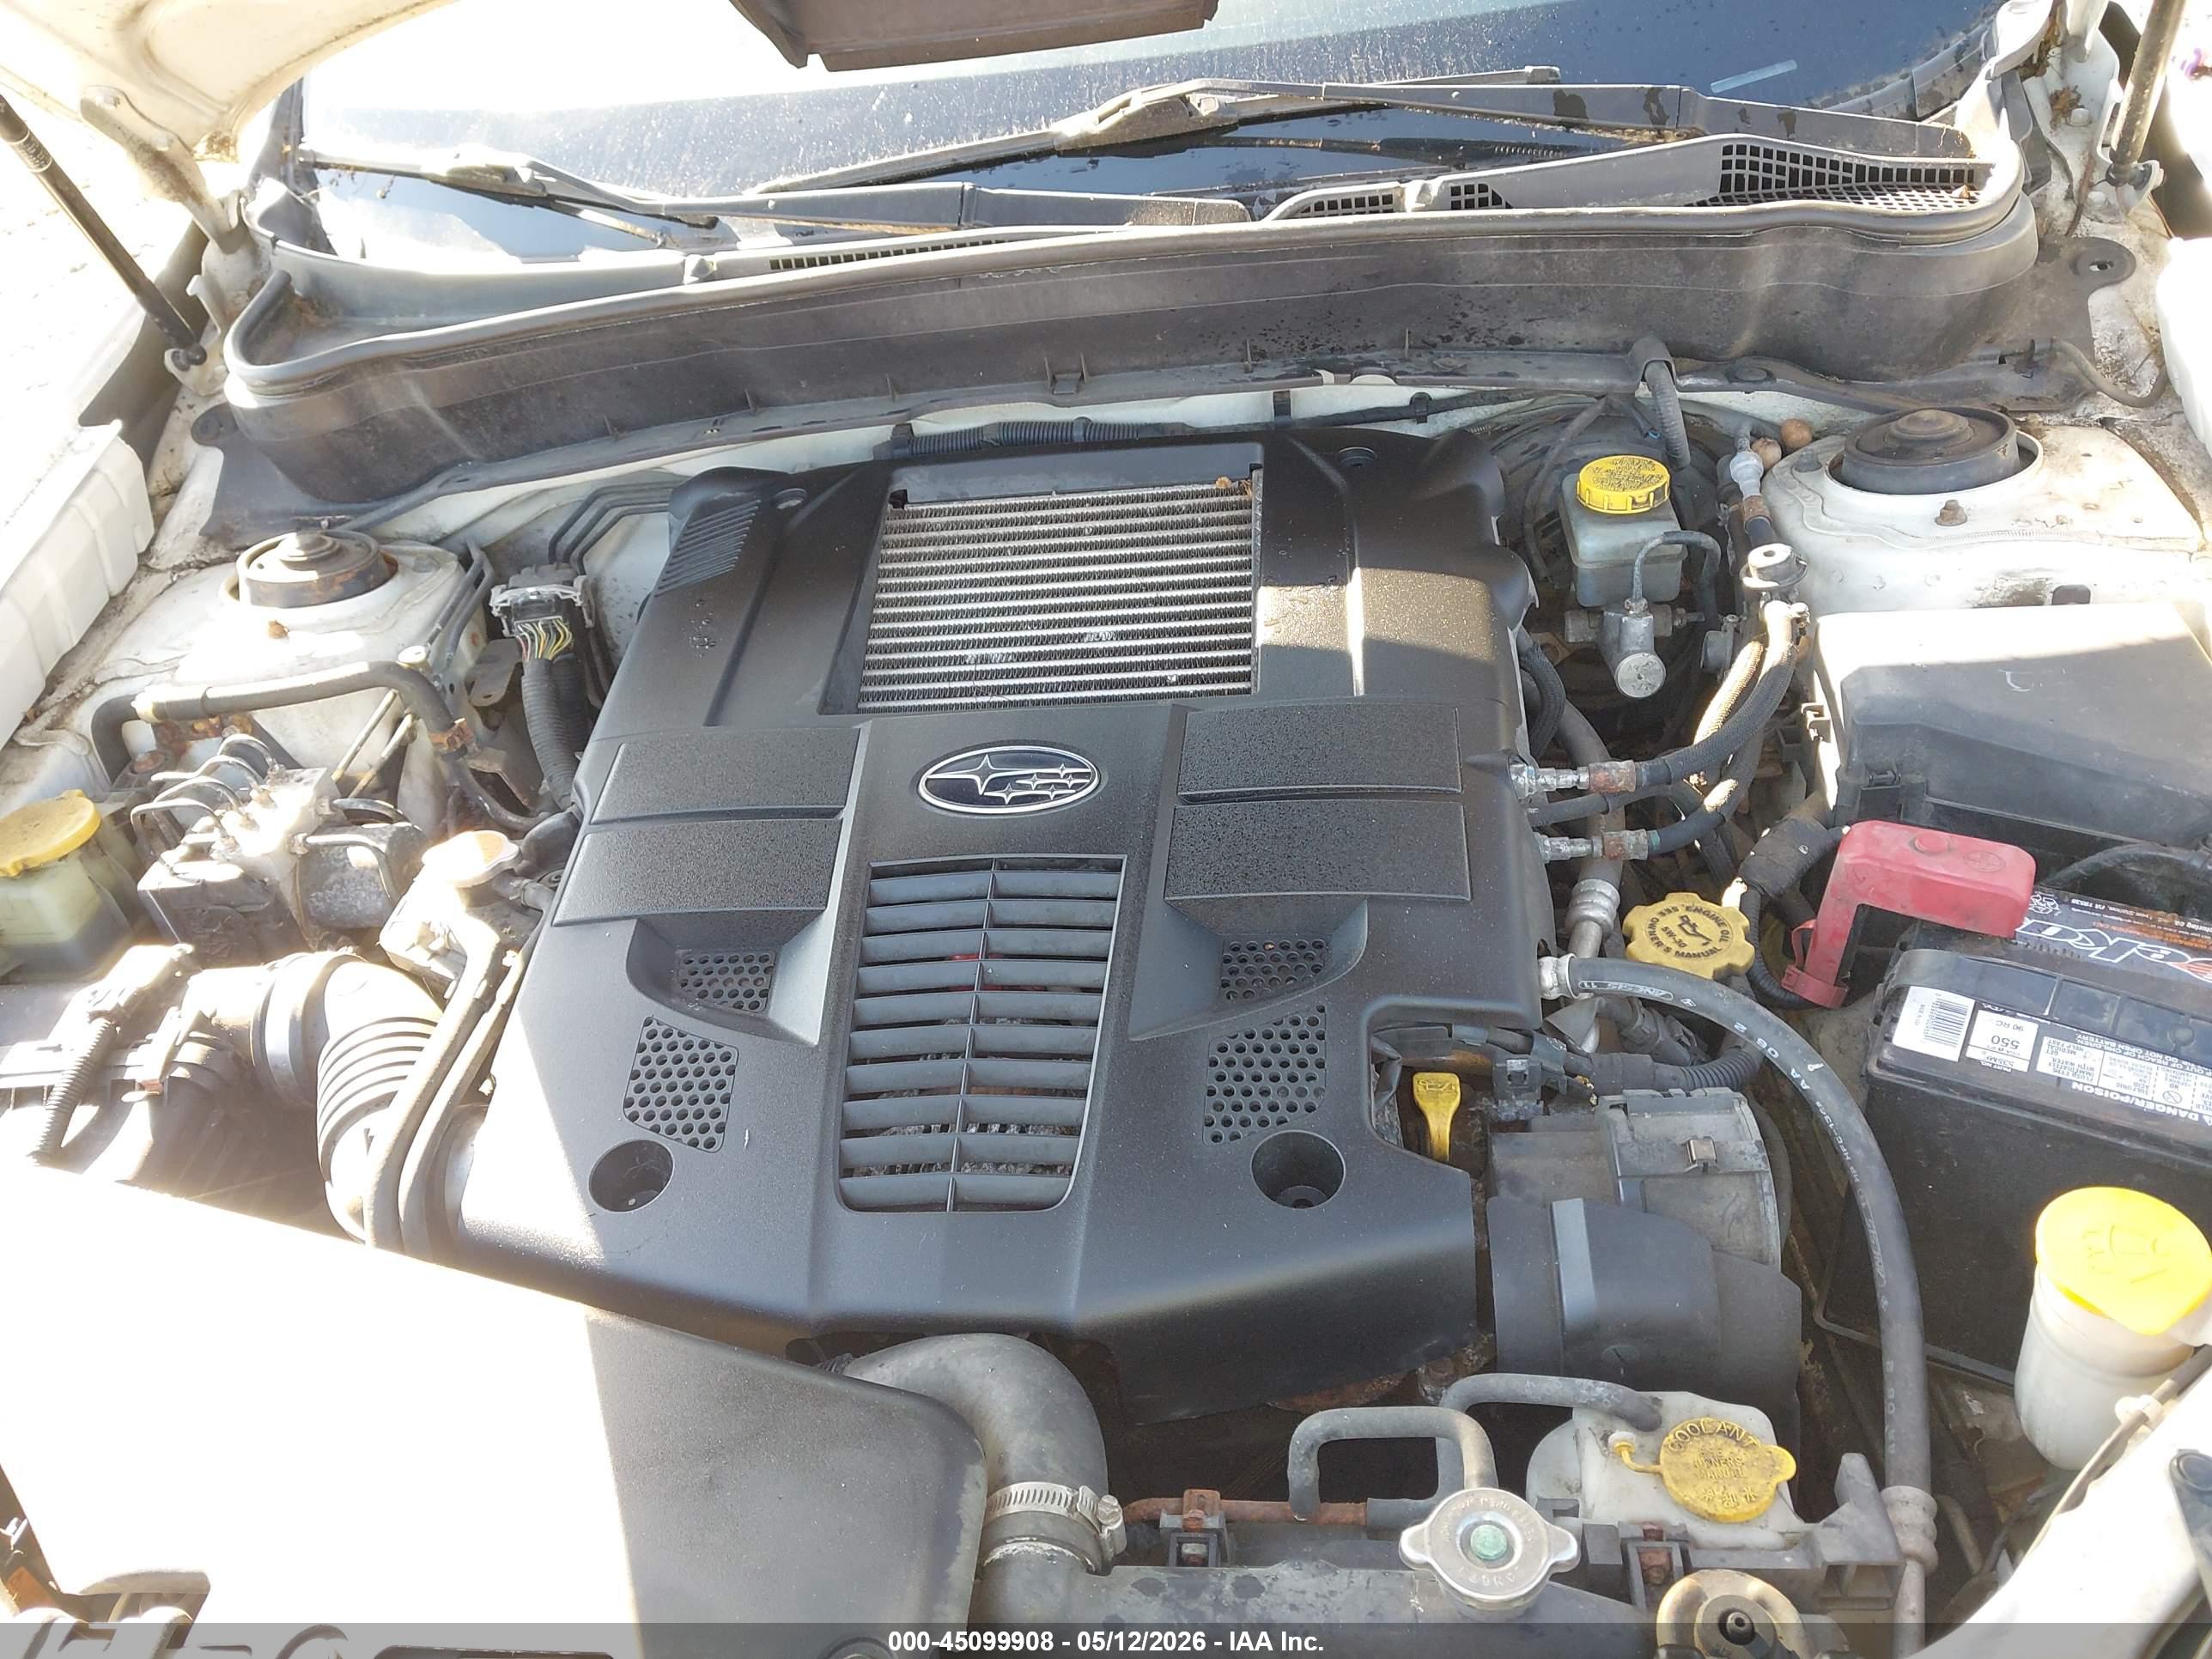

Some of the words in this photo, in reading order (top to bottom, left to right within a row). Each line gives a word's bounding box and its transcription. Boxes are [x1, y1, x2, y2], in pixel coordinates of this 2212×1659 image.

[1657, 906, 1679, 916] SEE
[1686, 905, 1728, 927] ENGINE
[1719, 929, 1730, 943] OIL
[1648, 917, 1672, 953] OWNER'S
[1661, 926, 1687, 948] 5W-30
[1674, 946, 1723, 958] MANUAL
[1734, 1021, 1747, 1033] 2
[1996, 1019, 2010, 1029] RC
[1991, 1035, 2021, 1049] 550
[2075, 1033, 2117, 1048] BATTERY.
[1756, 1037, 1779, 1059] 06
[2046, 1044, 2076, 1055] MEDICAL
[2064, 1043, 2084, 1052] HELP
[2137, 1054, 2168, 1066] REACH
[2145, 1050, 2163, 1059] NOT
[2052, 1063, 2094, 1077] IMMEDIATELY
[2052, 1067, 2069, 1077] EYES
[2185, 1066, 2204, 1075] OUT
[1791, 1067, 1811, 1090] AA
[2072, 1073, 2094, 1082] FLUSH
[2115, 1082, 2148, 1095] SULFURIC
[2071, 1081, 2199, 1121] DANGER/POISON
[1668, 1418, 1759, 1453] COOLANT
